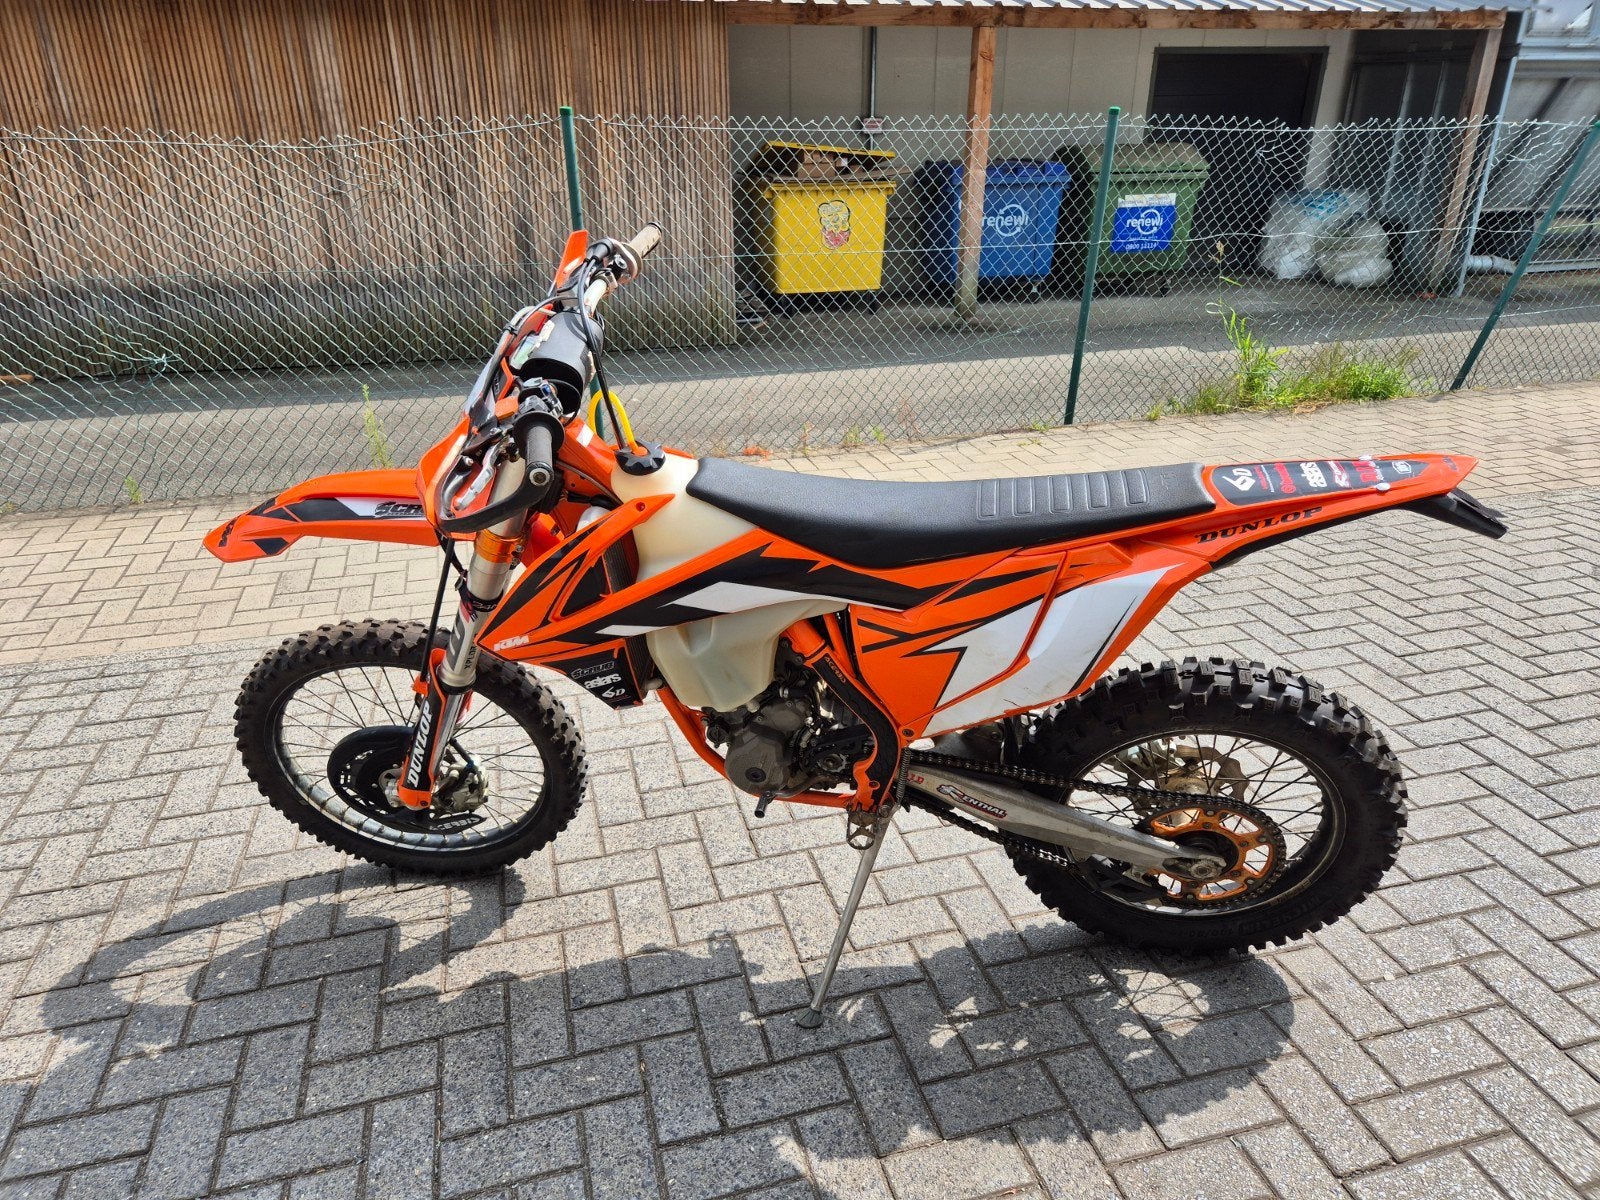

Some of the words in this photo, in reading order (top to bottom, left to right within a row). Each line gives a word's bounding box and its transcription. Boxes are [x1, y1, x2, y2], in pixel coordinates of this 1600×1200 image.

[1126, 214, 1164, 228] renewi
[1195, 506, 1322, 543] DUNLOP
[493, 635, 530, 650] KTM
[407, 700, 432, 788] DUNLOP
